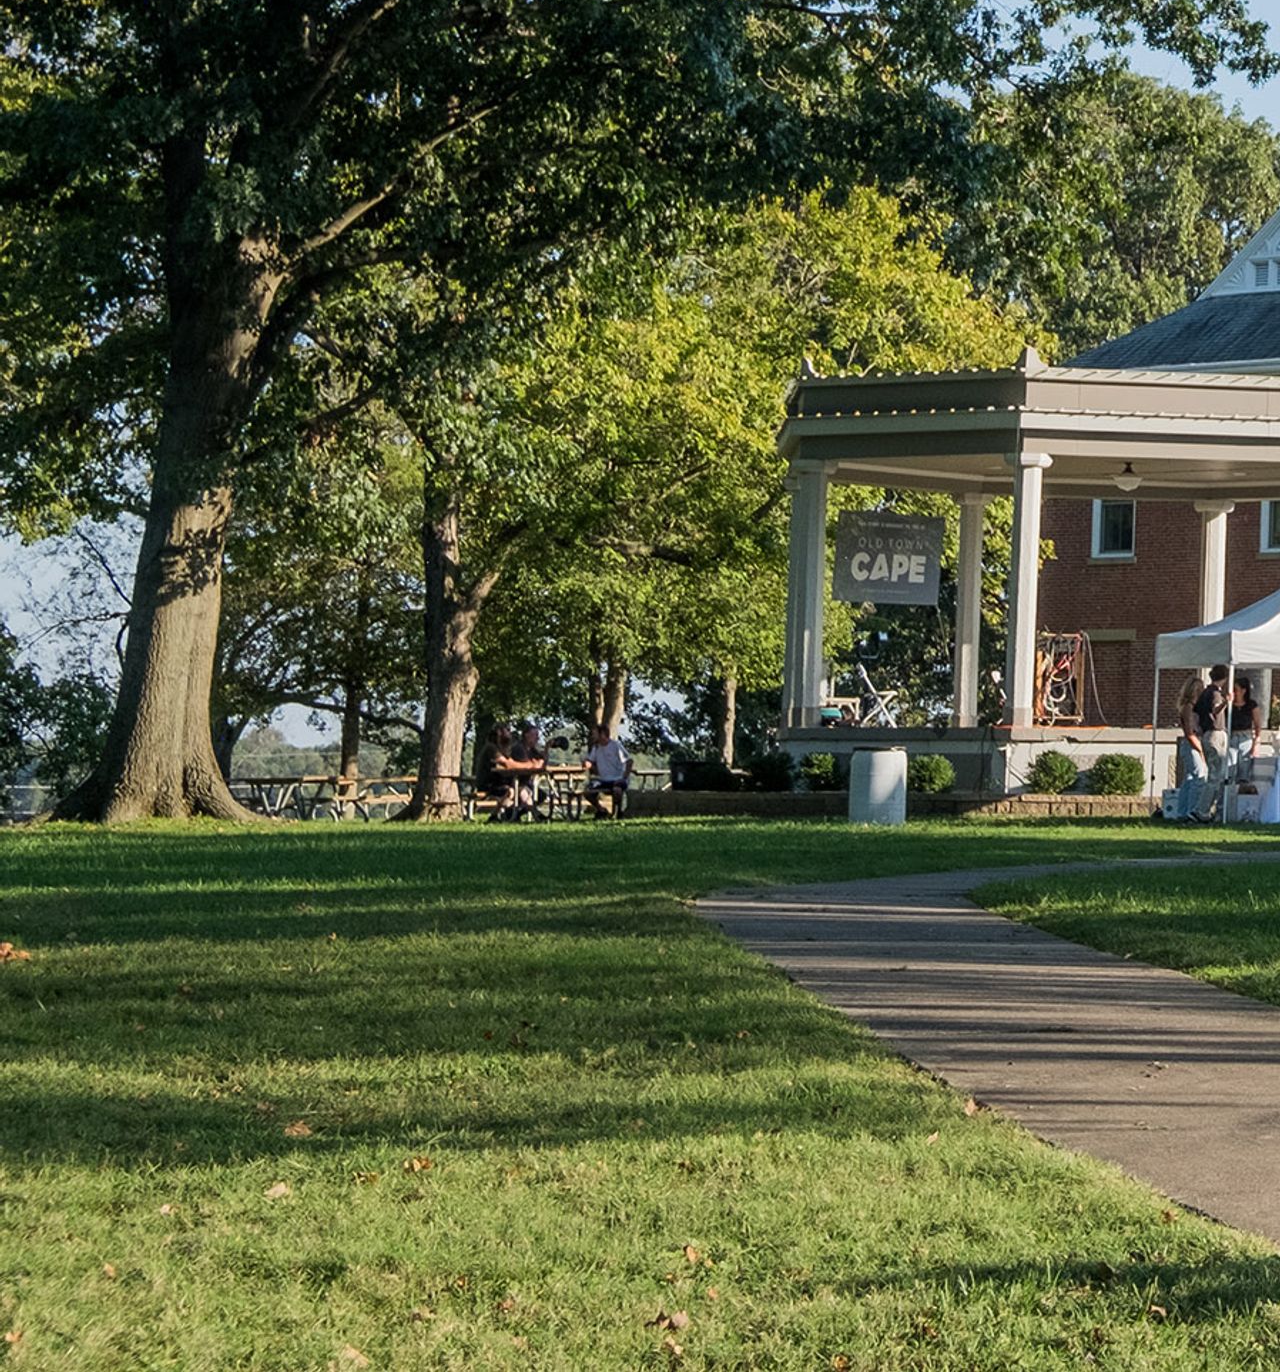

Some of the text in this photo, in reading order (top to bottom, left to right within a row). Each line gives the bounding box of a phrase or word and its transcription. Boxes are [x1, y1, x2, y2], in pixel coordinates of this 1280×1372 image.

[858, 537, 924, 549] OLD TOWN
[851, 552, 927, 583] CAPE
